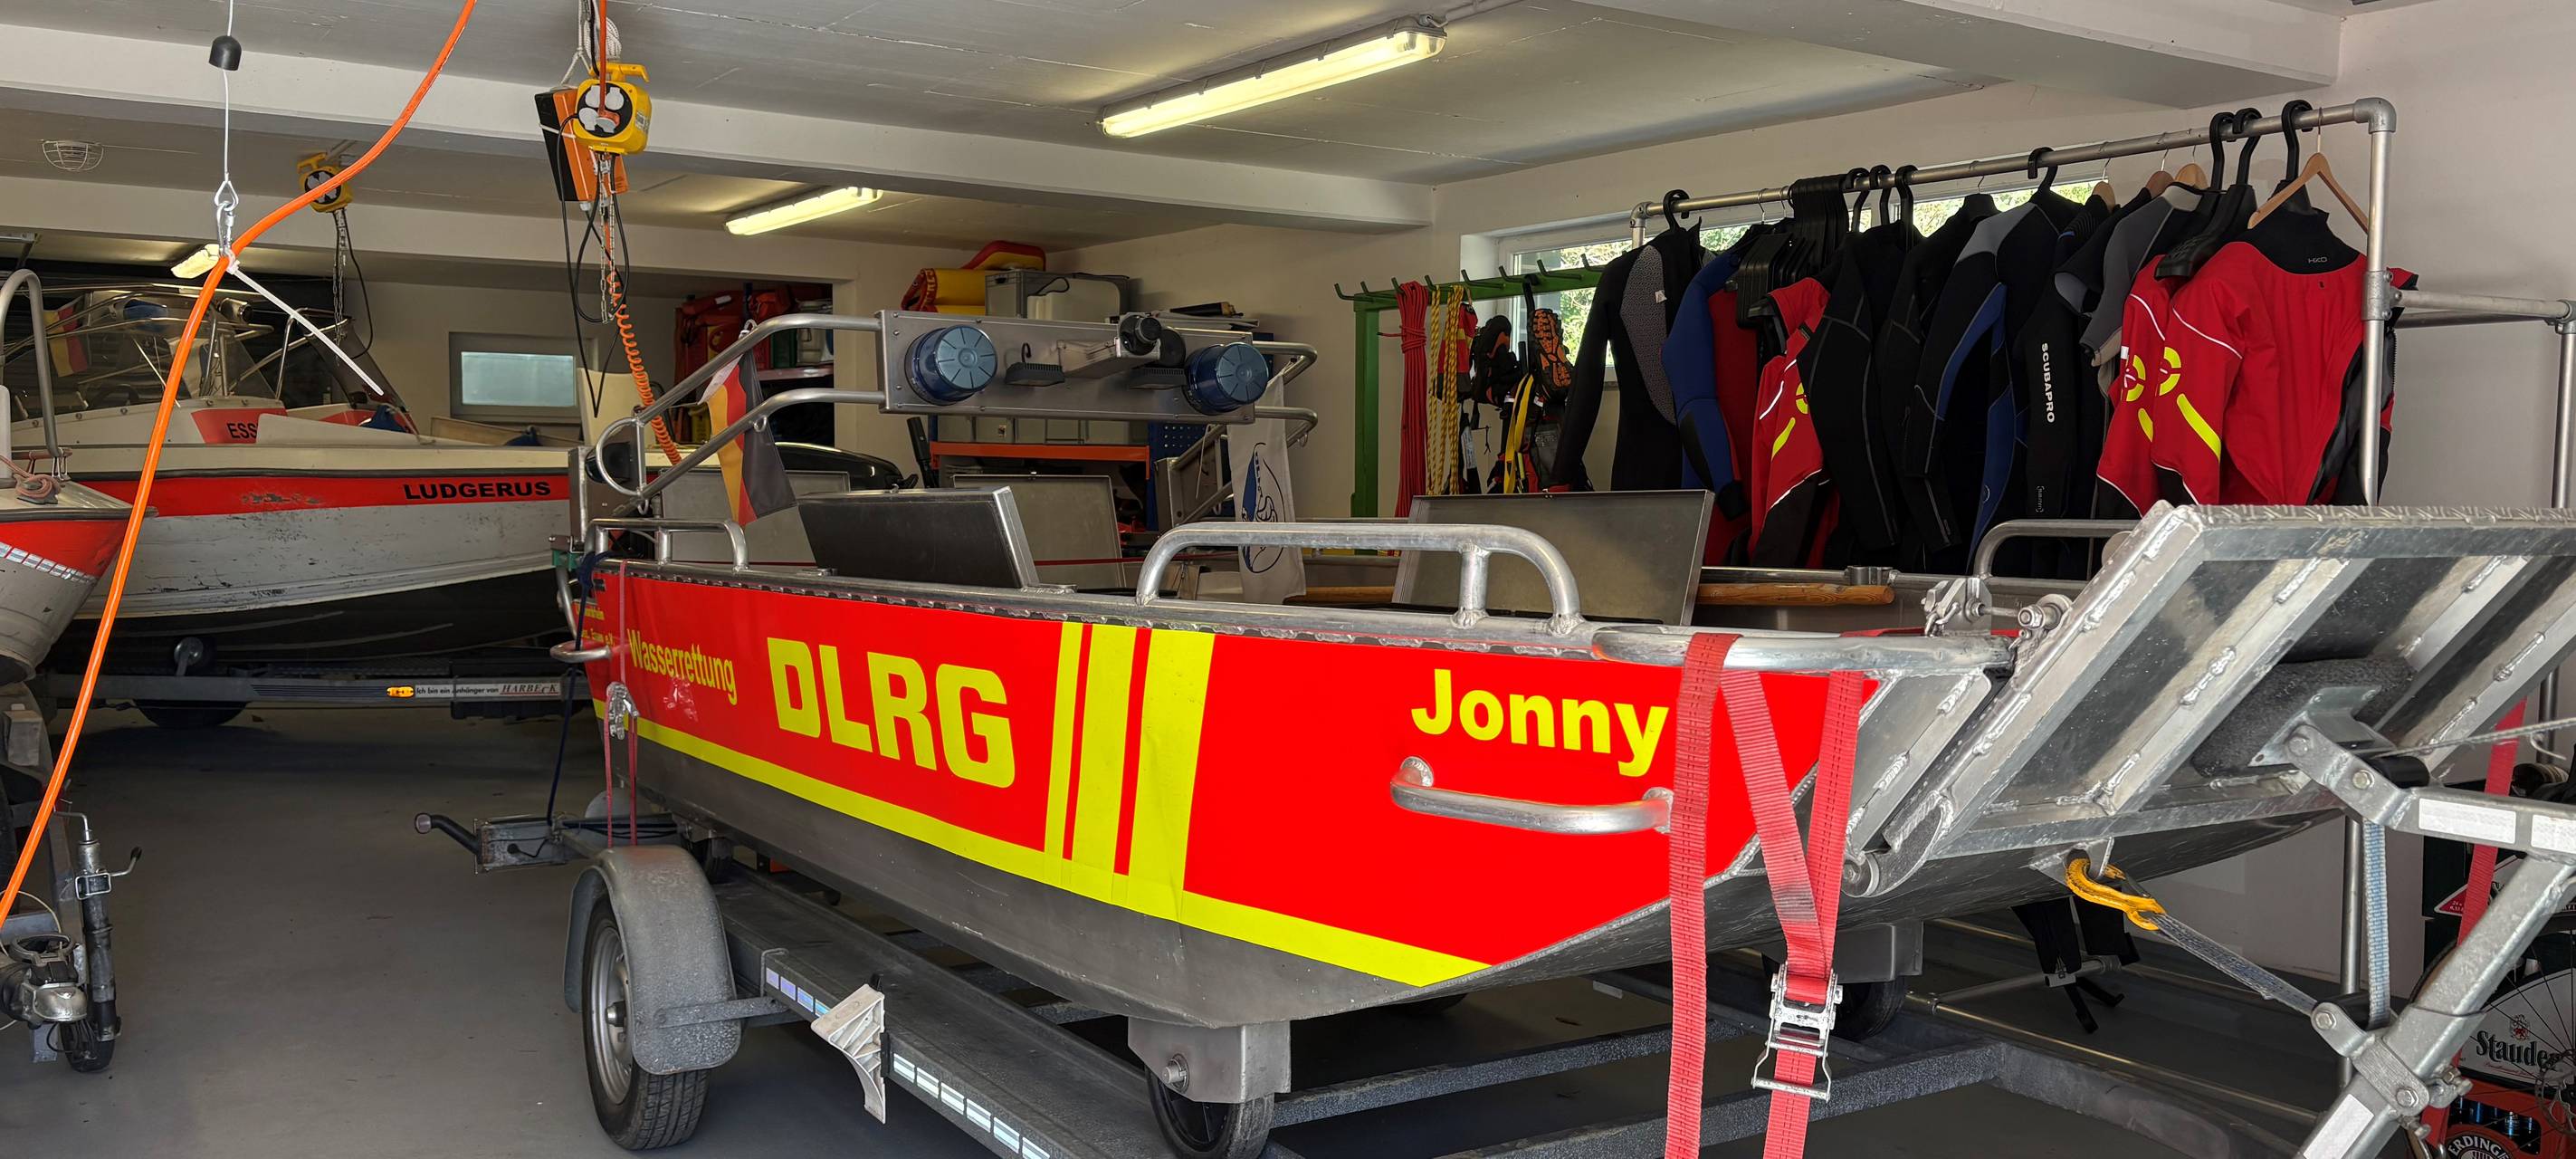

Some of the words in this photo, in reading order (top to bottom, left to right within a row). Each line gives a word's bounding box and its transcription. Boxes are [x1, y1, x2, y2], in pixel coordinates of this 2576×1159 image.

[2041, 342, 2056, 424] SCUBAPRO
[226, 422, 258, 439] ESS
[404, 481, 551, 500] LUDGERUS
[416, 686, 426, 694] Ich
[626, 627, 738, 705] Wasserrettung
[767, 637, 1016, 789] DLRG
[1411, 668, 1670, 778] Jonny
[2476, 1030, 2554, 1069] Staude
